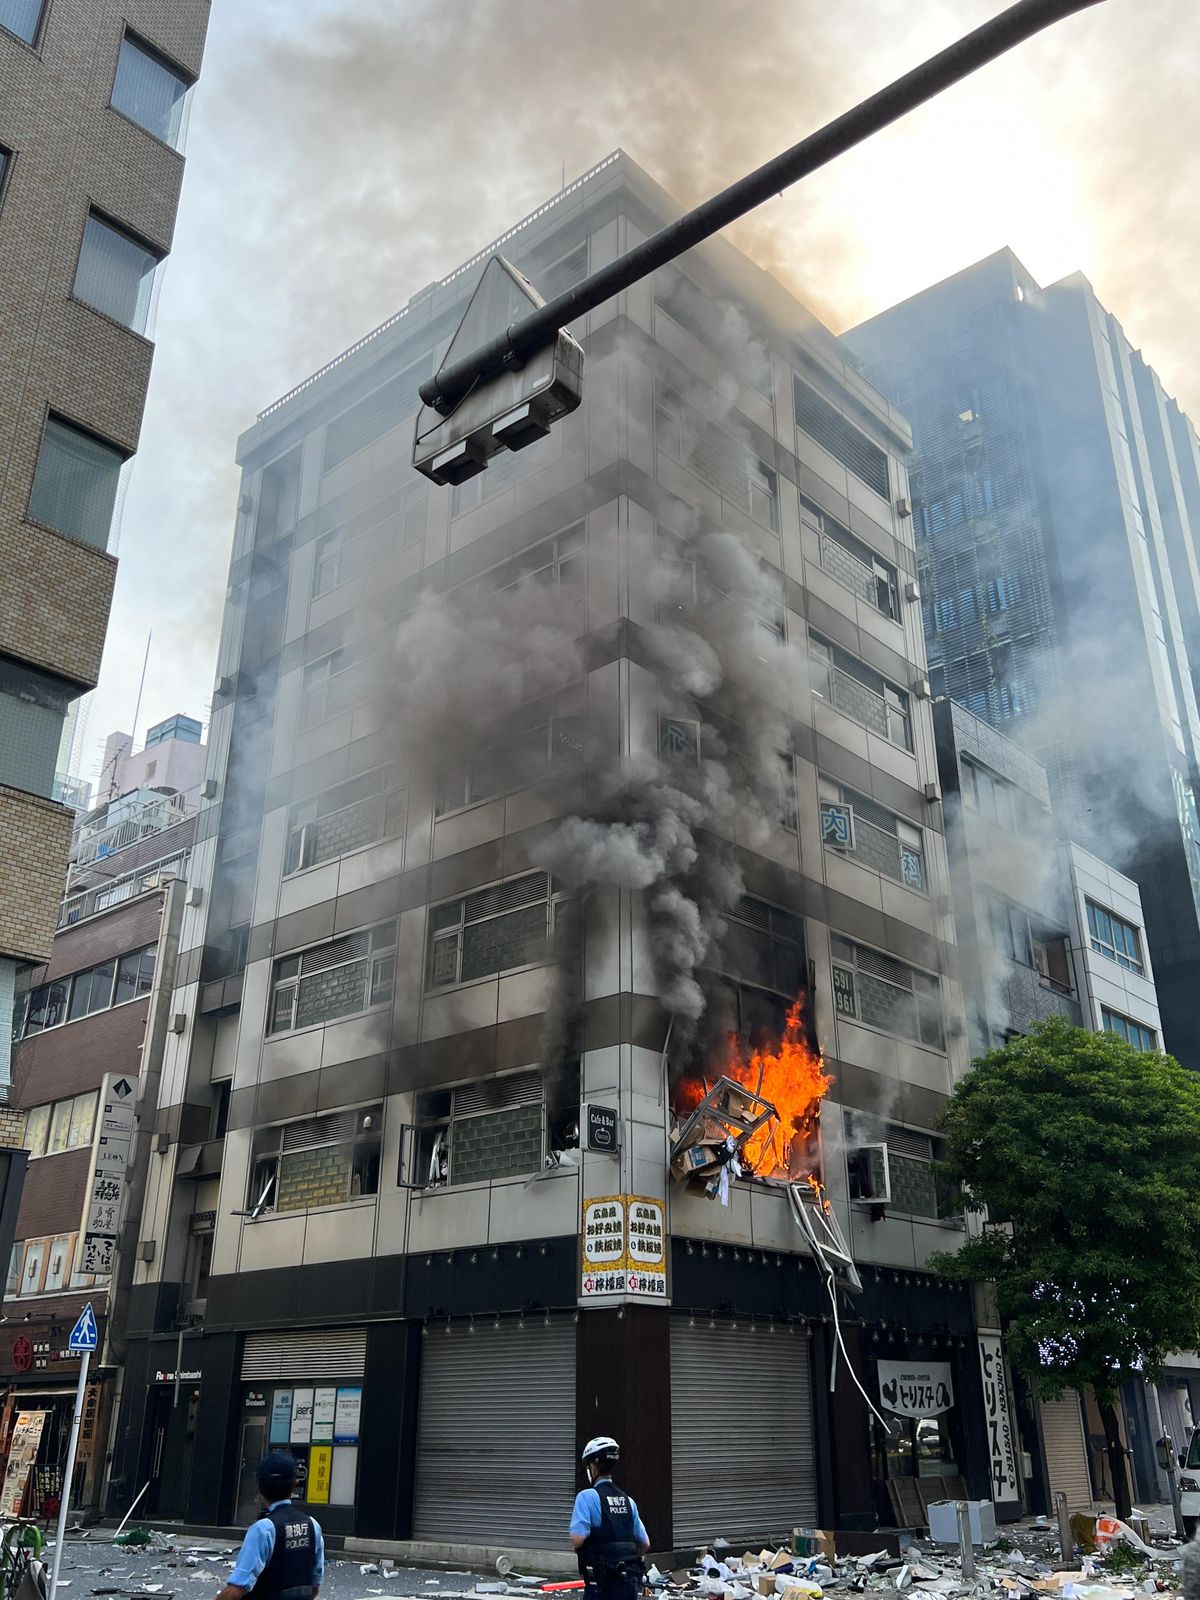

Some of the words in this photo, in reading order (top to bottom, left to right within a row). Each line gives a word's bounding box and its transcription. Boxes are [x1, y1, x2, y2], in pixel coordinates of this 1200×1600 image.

[820, 808, 849, 842] 内
[834, 970, 849, 990] 591
[590, 1113, 601, 1124] Cafe
[601, 1115, 606, 1126] &
[605, 1116, 615, 1127] Bar
[593, 1207, 617, 1219] 広島風
[636, 1208, 656, 1220] 広島風
[587, 1221, 622, 1235] お好み焼
[630, 1221, 661, 1237] お好み焼
[595, 1239, 622, 1253] 鉄板焼
[638, 1240, 661, 1254] 鉄板焼
[595, 1276, 625, 1292] 檸檬屋
[639, 1278, 664, 1292] 檸檬屋
[900, 1385, 935, 1408] とりスタ
[980, 1343, 1007, 1496] とりスタ
[996, 1362, 1006, 1413] CHICKEN
[1002, 1424, 1014, 1473] OYSTER
[285, 1523, 309, 1538] 警視庁
[286, 1538, 309, 1549] POLICE
